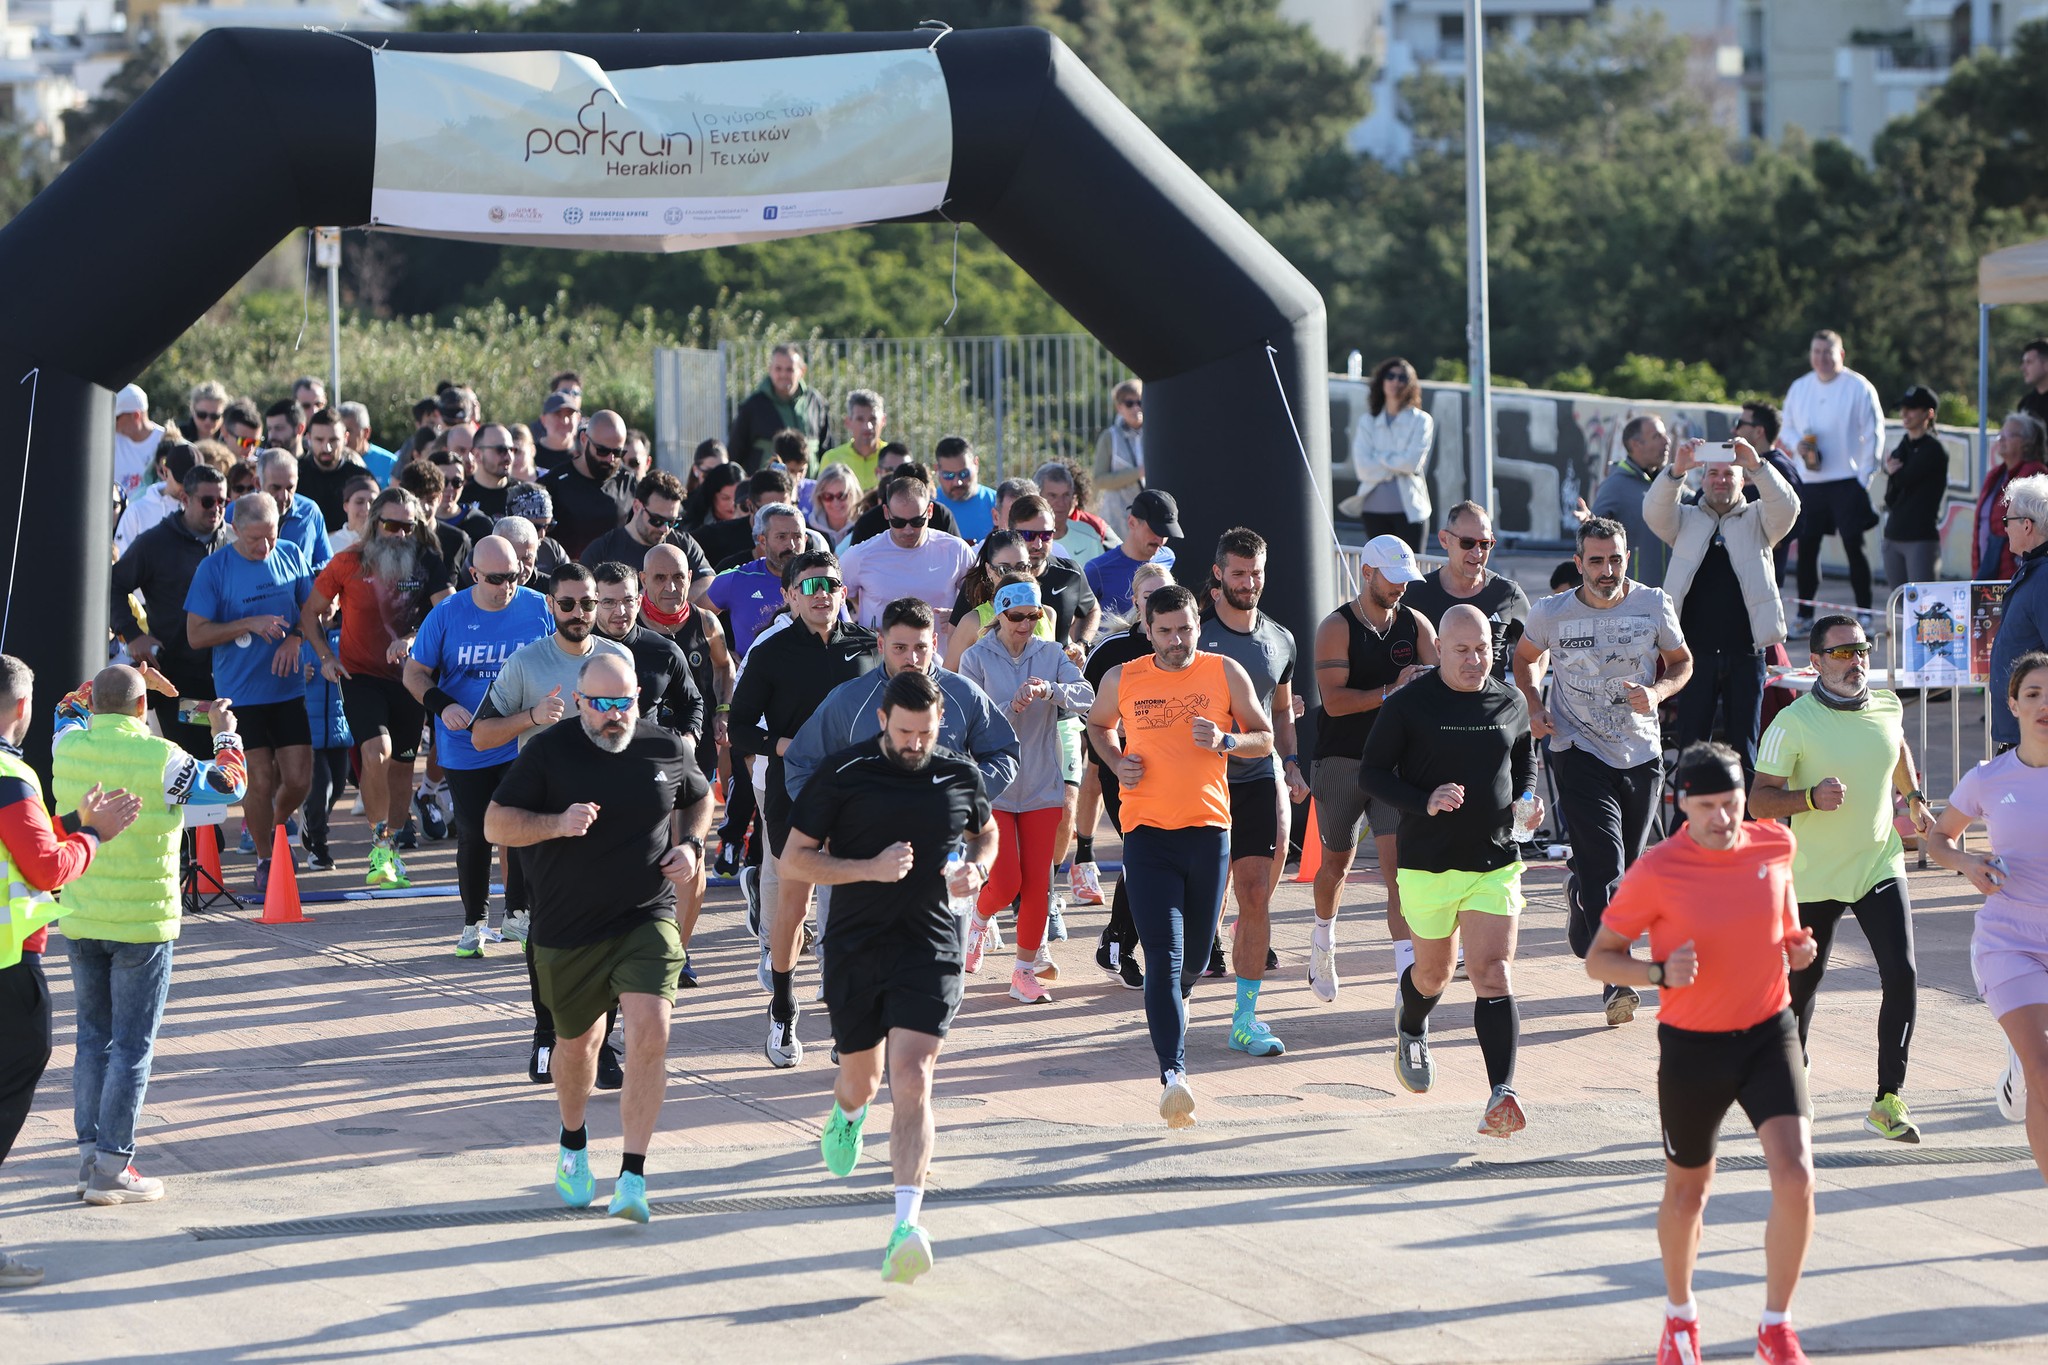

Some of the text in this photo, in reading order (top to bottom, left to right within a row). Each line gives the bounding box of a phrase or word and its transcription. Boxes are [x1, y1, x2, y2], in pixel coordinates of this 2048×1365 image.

[525, 108, 692, 162] parkrun
[710, 125, 791, 144] Ενετικών
[710, 148, 770, 166] Τειχών
[606, 161, 692, 176] Heraklion
[1562, 639, 1593, 648] Zero
[479, 670, 501, 678] RUN
[1569, 674, 1604, 688] Hour
